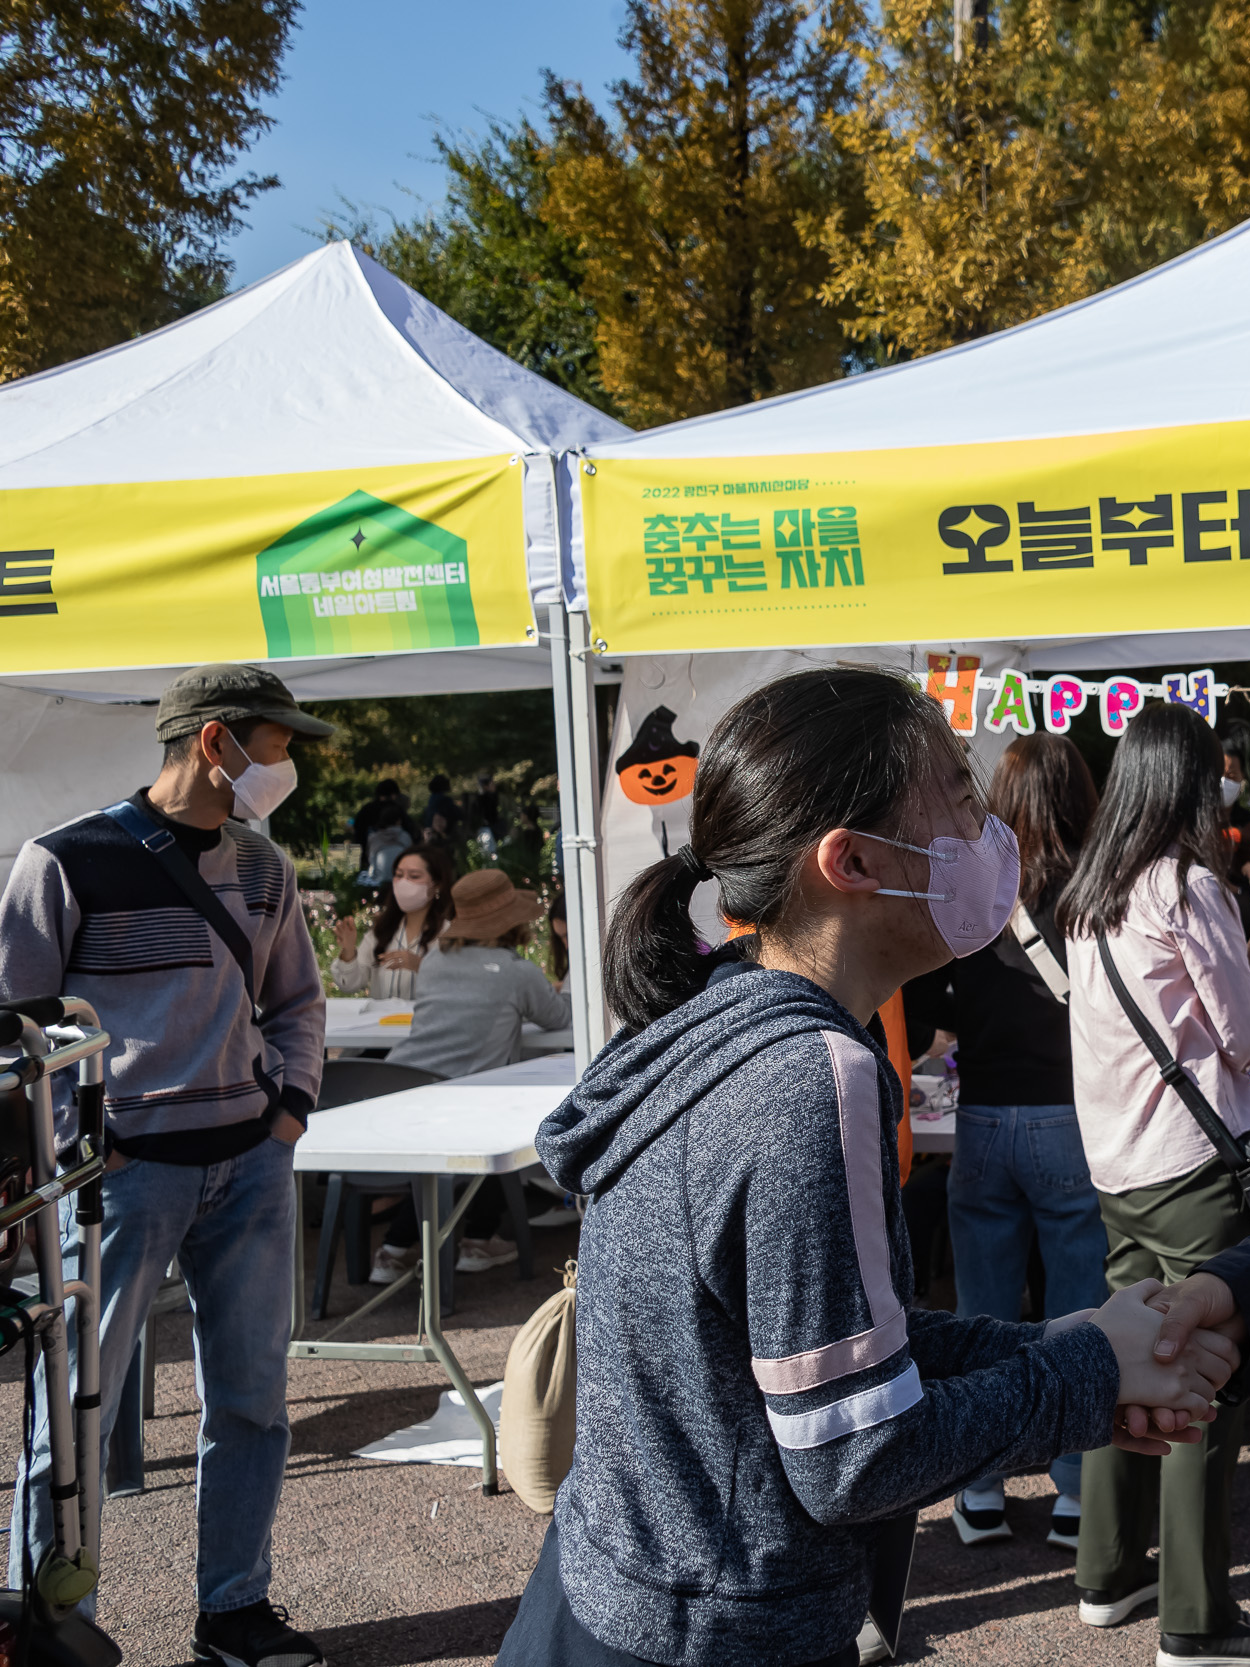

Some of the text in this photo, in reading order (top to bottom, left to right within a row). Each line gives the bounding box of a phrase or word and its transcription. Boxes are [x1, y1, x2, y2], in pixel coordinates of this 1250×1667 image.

[642, 479, 810, 499] 2022 광진구 마을자치한마당
[643, 506, 860, 554] 춤추는 마을
[260, 561, 467, 598] 서울동부여성발전센터
[645, 547, 865, 596] 꿈꾸는 자치
[925, 653, 1212, 733] HAPPY
[957, 920, 979, 932] Aer
